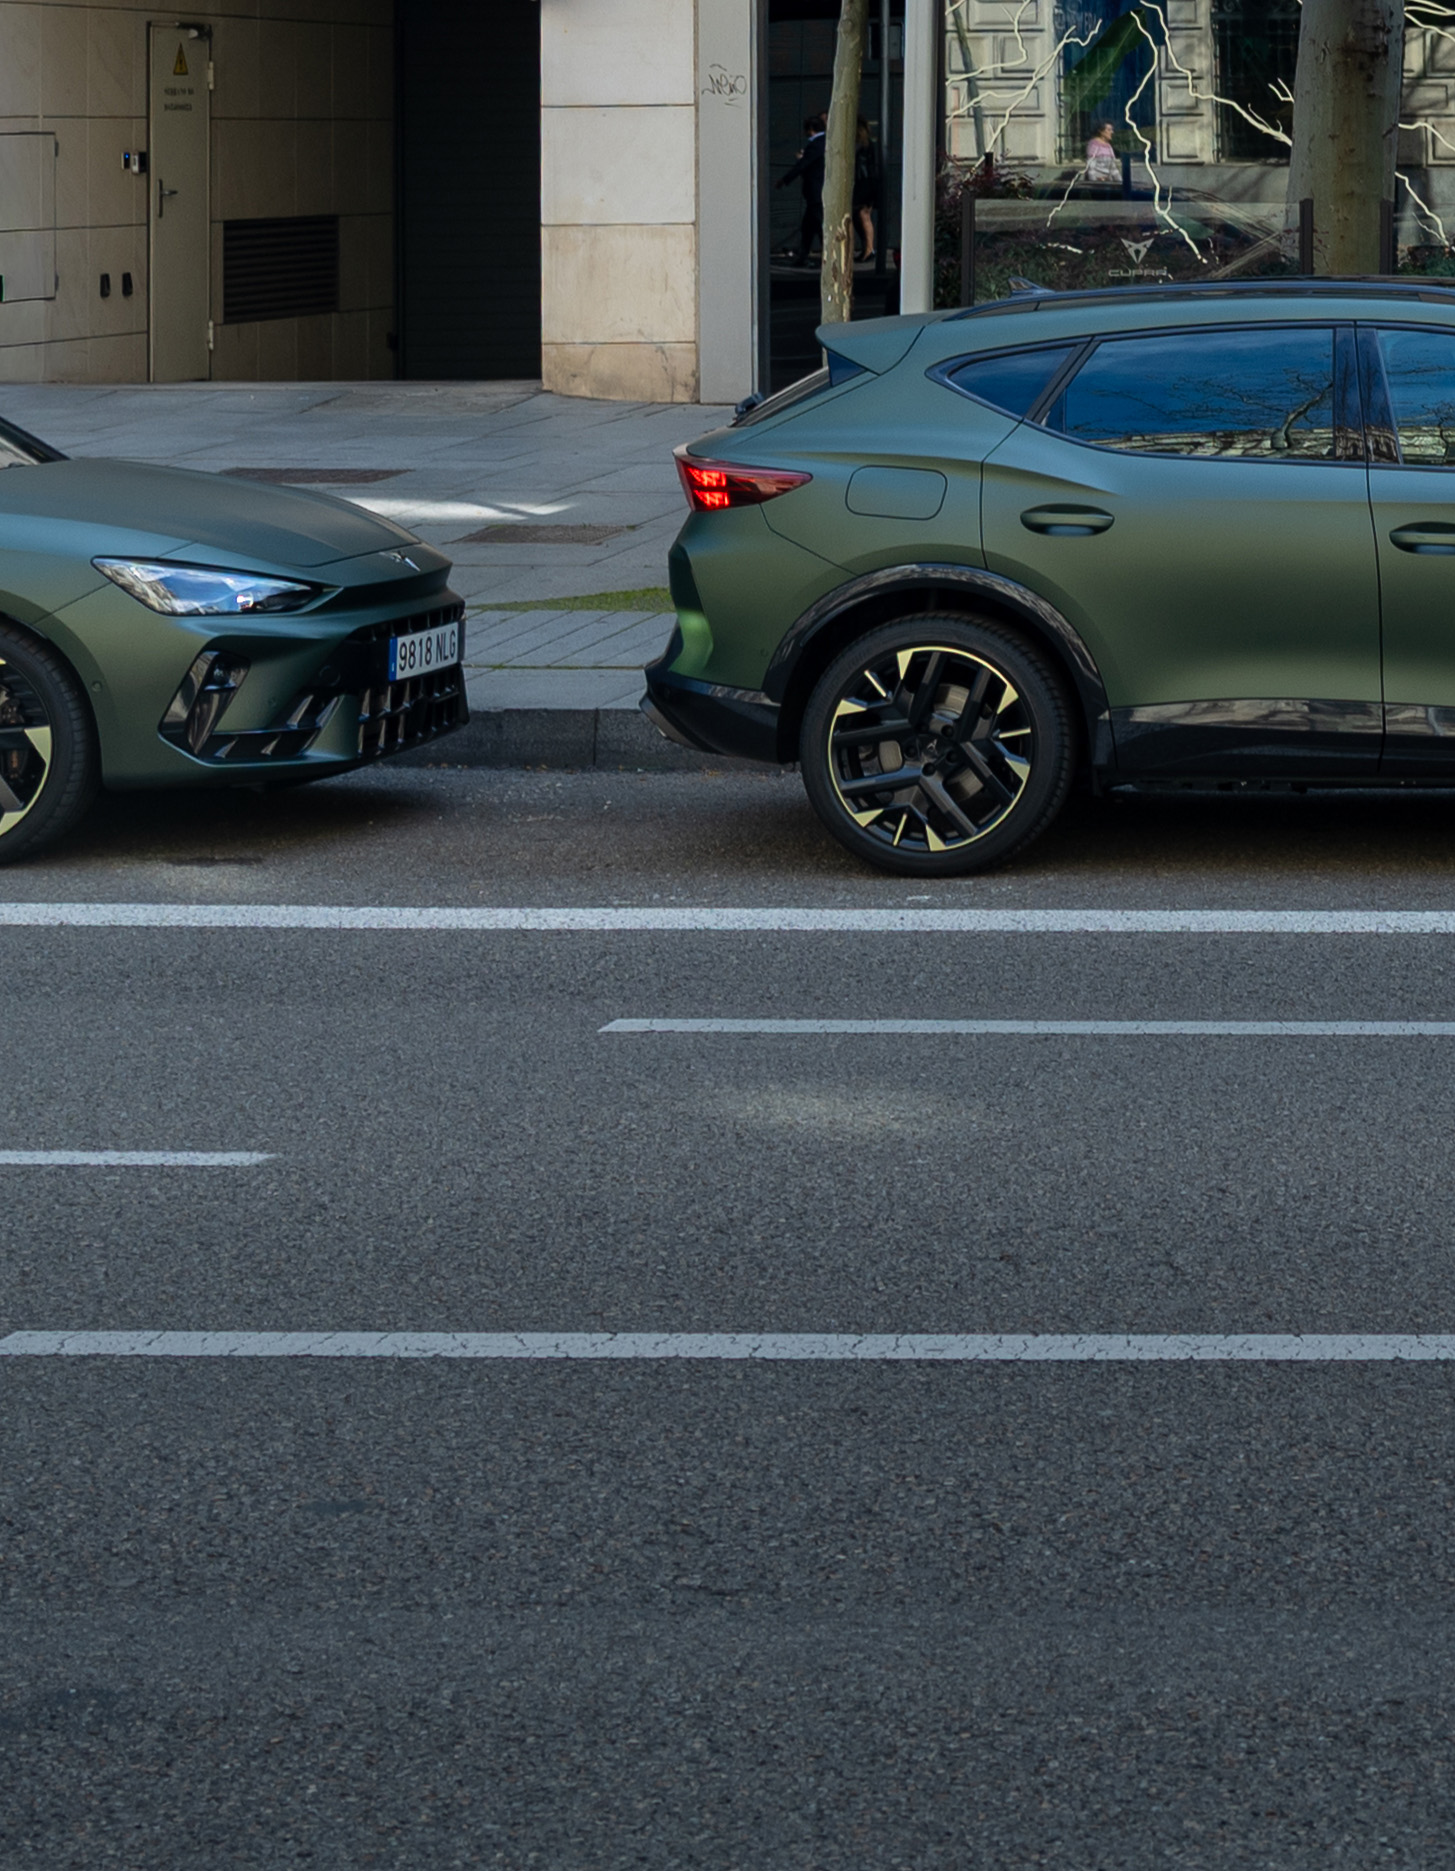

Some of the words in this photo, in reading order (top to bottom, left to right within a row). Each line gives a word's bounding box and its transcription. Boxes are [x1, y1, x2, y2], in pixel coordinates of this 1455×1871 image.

[1108, 268, 1168, 277] CUPRA
[399, 636, 433, 672] 9818
[435, 629, 456, 663] NLG
